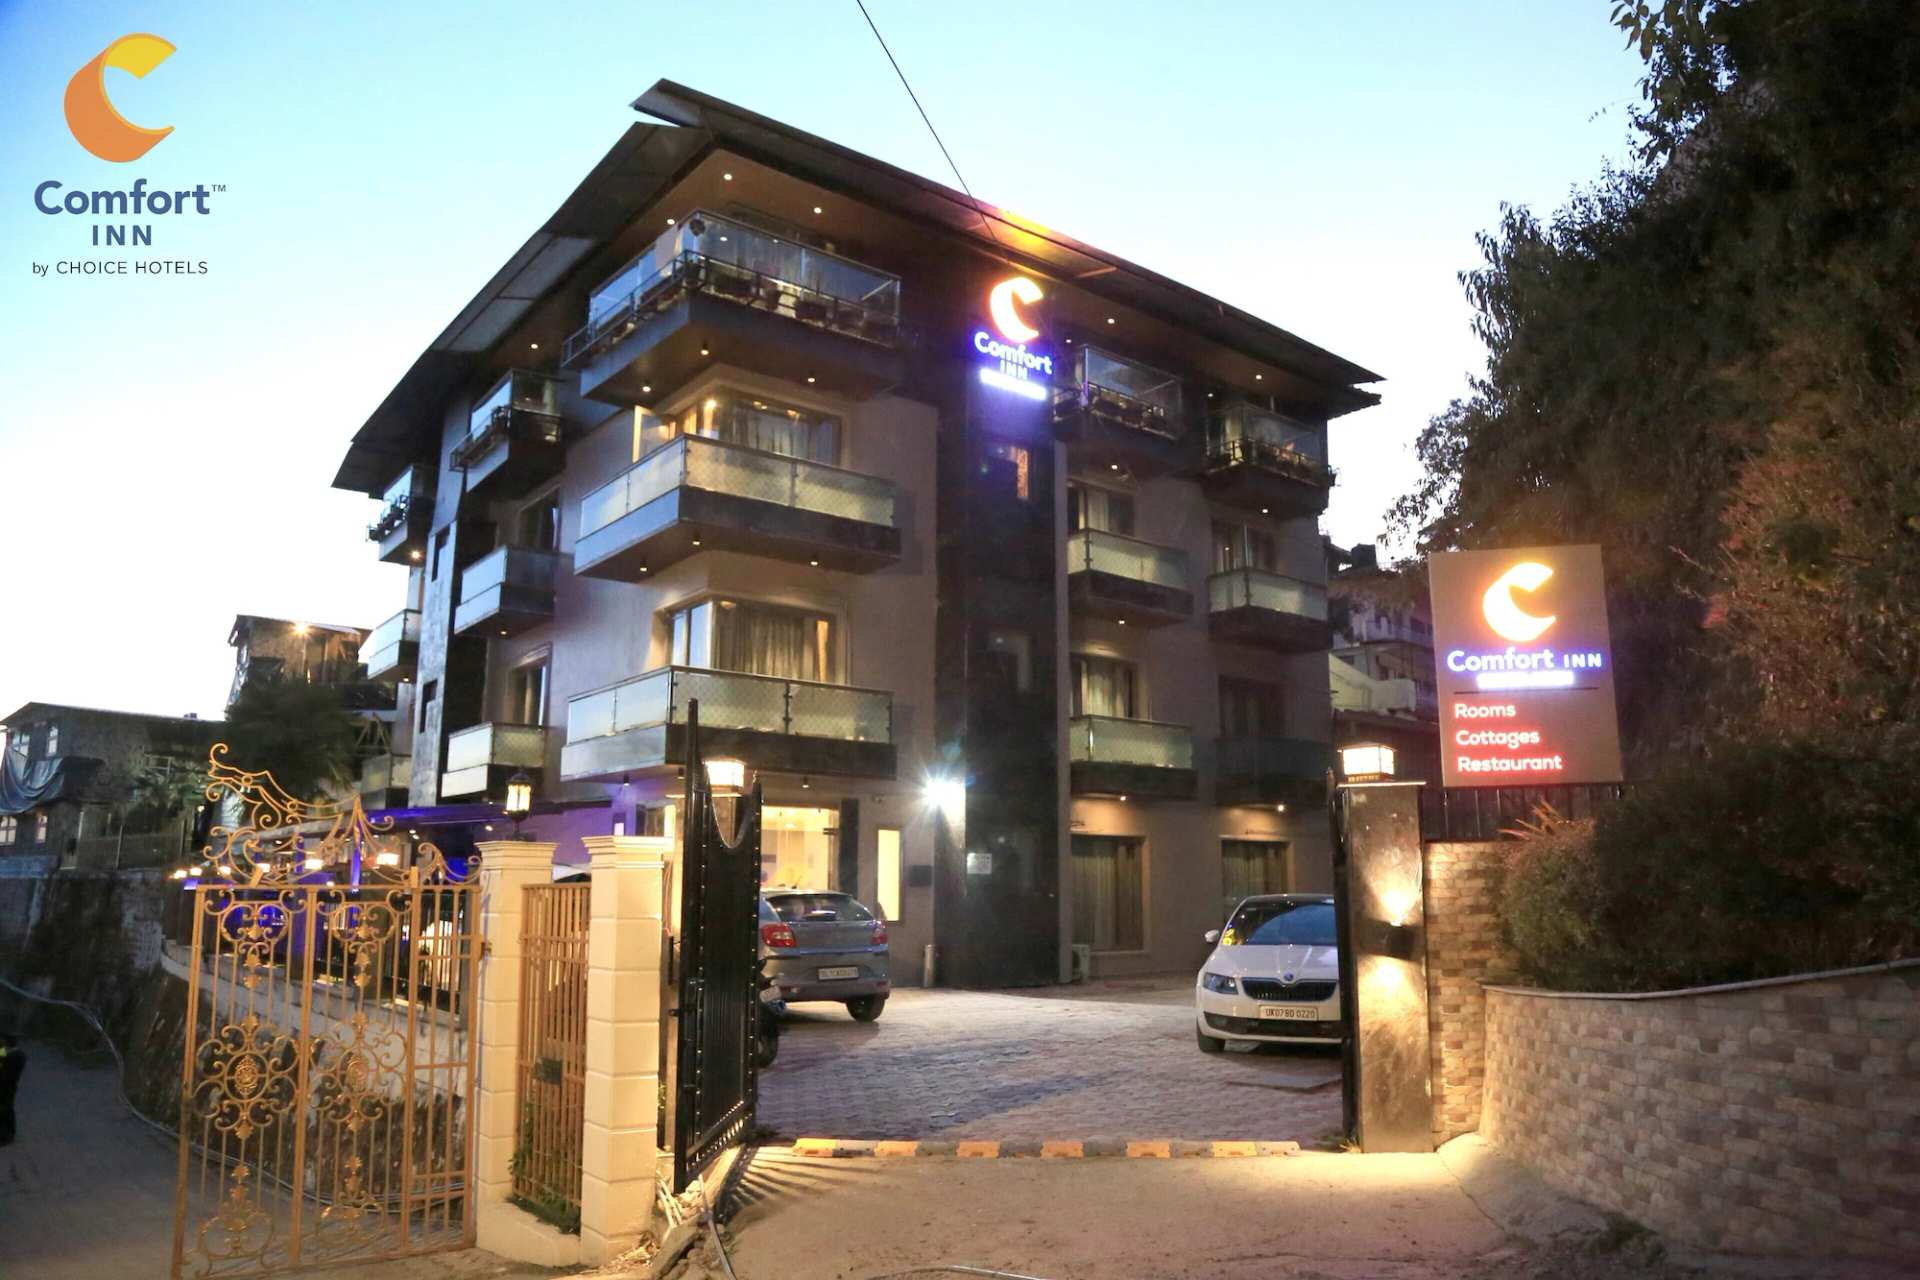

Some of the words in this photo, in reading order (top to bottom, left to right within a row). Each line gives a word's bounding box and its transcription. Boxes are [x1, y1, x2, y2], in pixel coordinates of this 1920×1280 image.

[974, 331, 1053, 374] Comfort
[1447, 647, 1554, 672] Comfort
[1564, 653, 1602, 667] INN
[1454, 703, 1516, 718] Rooms
[1455, 730, 1540, 749] Cottages
[1457, 755, 1563, 772] Restaurant
